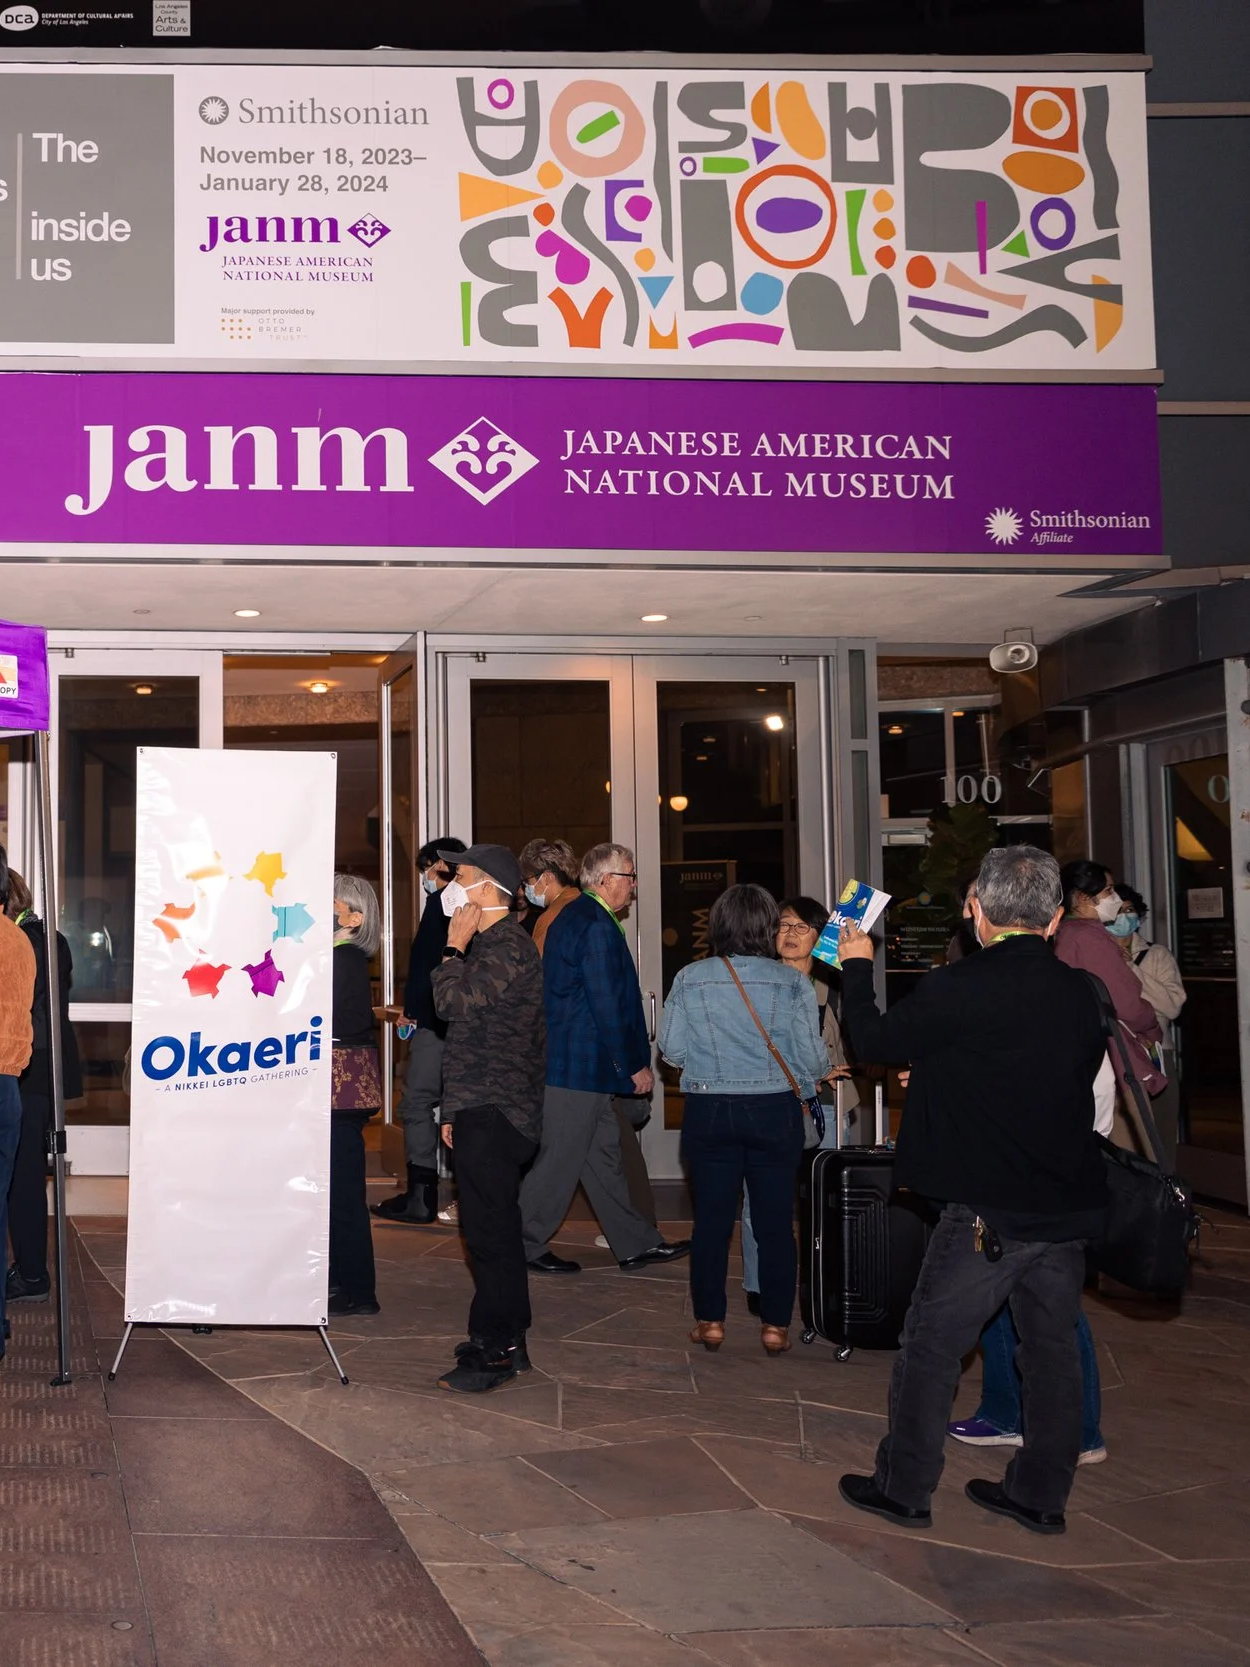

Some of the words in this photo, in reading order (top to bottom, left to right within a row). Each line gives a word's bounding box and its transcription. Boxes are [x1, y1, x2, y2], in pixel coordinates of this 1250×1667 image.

[155, 15, 178, 24] Arts
[239, 97, 430, 125] Smithsonian
[32, 133, 99, 163] The
[200, 146, 315, 164] November
[323, 148, 354, 168] 18,
[199, 173, 290, 196] January
[297, 174, 329, 195] 28,
[336, 175, 388, 192] 2024
[31, 211, 132, 242] inside
[199, 216, 341, 252] janm
[31, 258, 72, 281] us
[221, 256, 291, 268] JAPANESE
[295, 256, 373, 267] AMERICAN
[223, 270, 303, 281] NATIONAL
[308, 271, 373, 282] MUSEUM
[273, 307, 304, 315] provided
[306, 308, 315, 316] by
[560, 429, 741, 461] JAPANESE
[751, 433, 952, 460] AMERICAN
[64, 424, 415, 516] janm
[564, 468, 773, 497] NATIONAL
[784, 472, 955, 500] MUSEUM
[1030, 509, 1151, 528] Smithsonian
[1030, 531, 1074, 546] Affiliate
[940, 775, 1002, 804] 100
[141, 1015, 323, 1081] Okaeri
[164, 1084, 171, 1092] A
[175, 1079, 209, 1091] NIKKEI
[212, 1076, 247, 1089] LGBTQ
[250, 1066, 309, 1084] GATHERING
